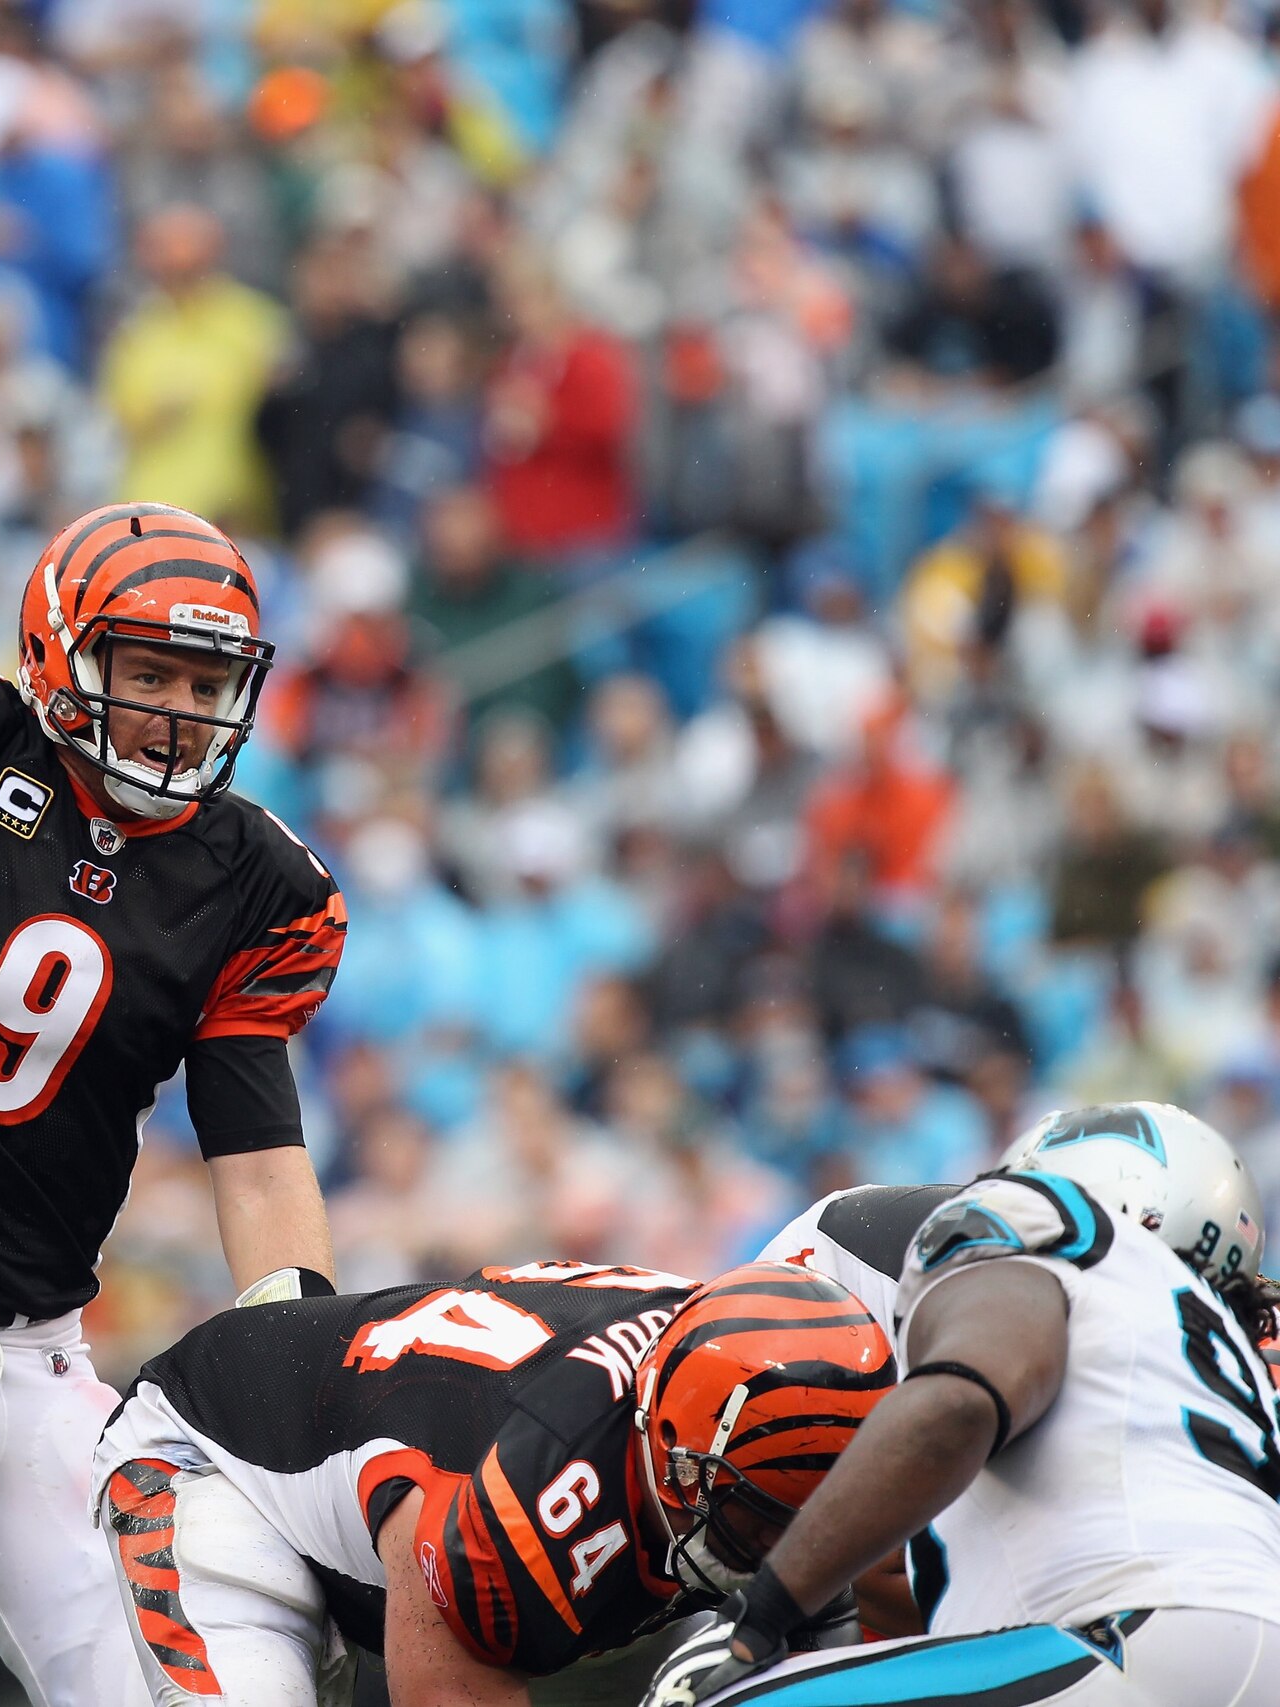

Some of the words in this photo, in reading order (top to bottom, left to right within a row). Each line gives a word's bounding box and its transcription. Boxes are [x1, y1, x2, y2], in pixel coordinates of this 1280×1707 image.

[192, 609, 230, 625] Riddell
[69, 860, 118, 904] B
[536, 1459, 631, 1600] 64
